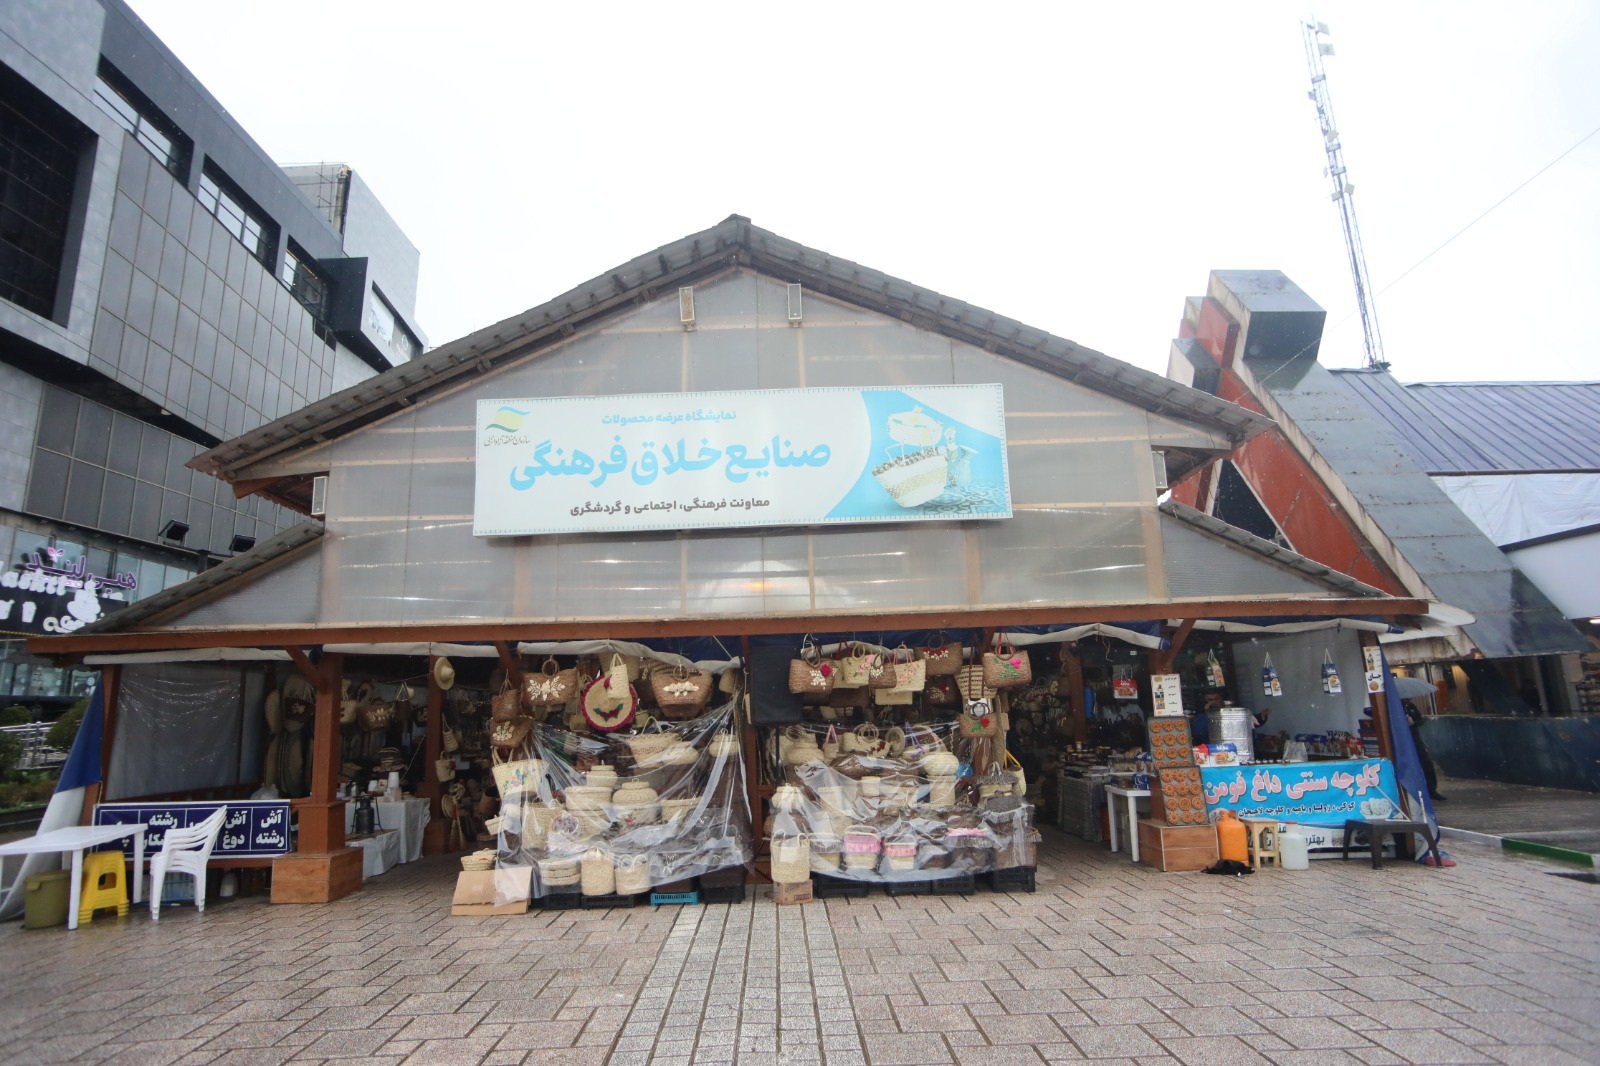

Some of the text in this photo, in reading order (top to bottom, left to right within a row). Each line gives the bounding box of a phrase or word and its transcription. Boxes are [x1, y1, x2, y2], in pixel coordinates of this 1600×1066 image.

[601, 408, 737, 426] نمایشگاه عرضه محصولات
[510, 434, 831, 491] صنایع خلاق فرهنگی
[570, 500, 622, 516] گردشگری
[624, 503, 631, 514] و
[633, 500, 677, 514] اجتماعی
[729, 498, 770, 510] معاونت
[1204, 763, 1381, 804] کلوچه سنتی داغ فومن
[225, 810, 248, 828] آش
[260, 809, 283, 828] آش
[1265, 806, 1284, 815] کلوچه
[148, 812, 178, 829] رشته
[222, 830, 245, 849] دوغ
[256, 830, 285, 847] رشته
